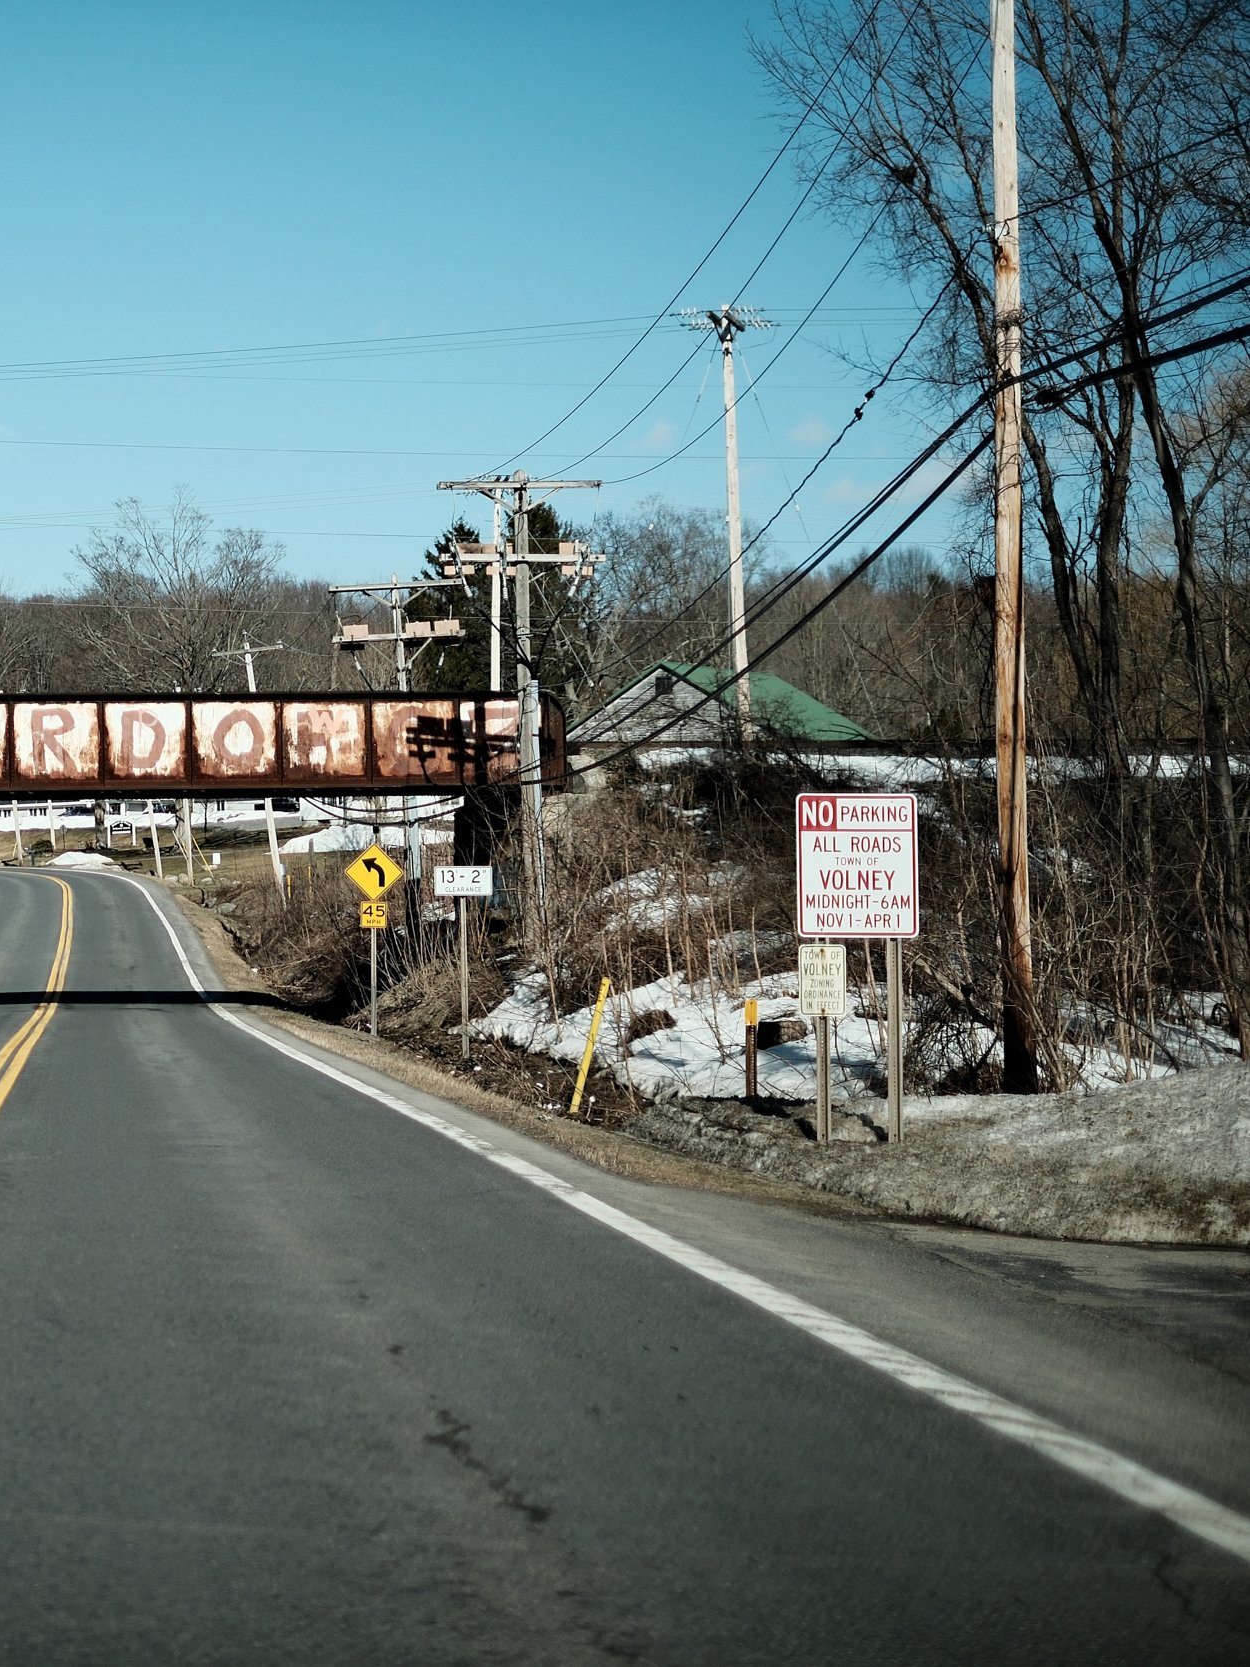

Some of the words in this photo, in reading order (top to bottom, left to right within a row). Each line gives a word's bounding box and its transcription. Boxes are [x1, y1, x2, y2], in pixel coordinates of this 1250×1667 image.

[802, 801, 834, 827] NO
[840, 806, 908, 822] PARKING
[813, 836, 841, 852] ALL
[851, 837, 901, 852] ROADS
[835, 857, 861, 865] TOWN
[867, 857, 879, 866] OF
[819, 870, 895, 890] VOLNEY
[363, 905, 385, 917] 45
[816, 913, 843, 927] NOV
[804, 950, 826, 960] TOWN
[830, 951, 841, 960] OF
[803, 963, 841, 976] VOLNEY
[810, 979, 834, 988] ZONING
[804, 990, 841, 999] ORDINANCE
[806, 1001, 813, 1010] IN
[817, 1001, 839, 1009] EFFECT
